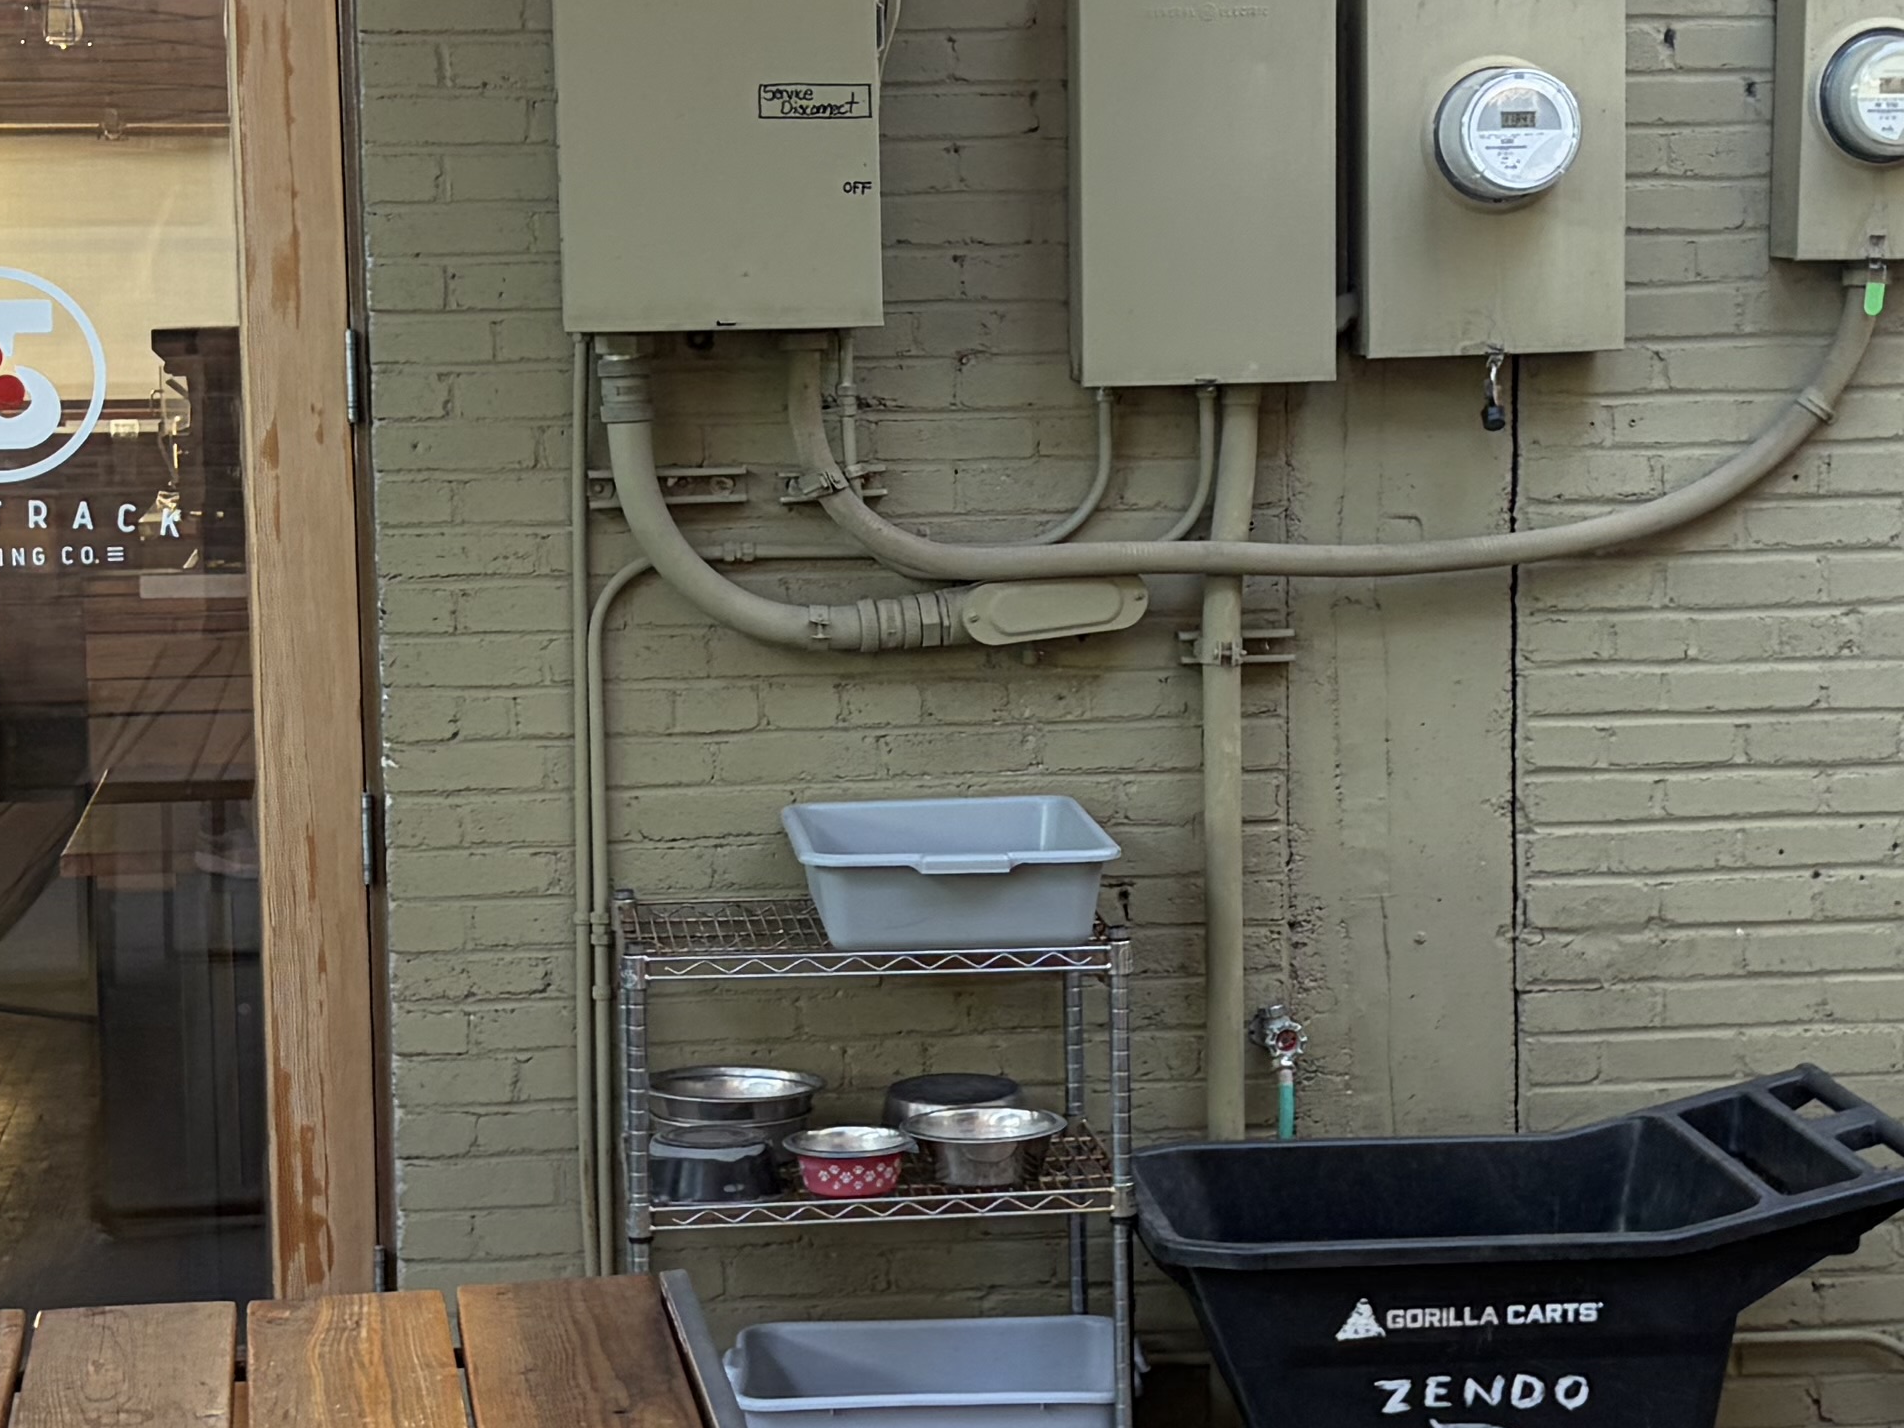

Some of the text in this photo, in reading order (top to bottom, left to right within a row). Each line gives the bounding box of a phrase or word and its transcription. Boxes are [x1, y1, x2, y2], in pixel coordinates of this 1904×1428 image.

[763, 85, 814, 102] Service
[842, 181, 872, 195] OFF
[61, 546, 100, 566] CO.
[1386, 1306, 1499, 1329] GORILLA
[1374, 1373, 1590, 1415] ZENDO
